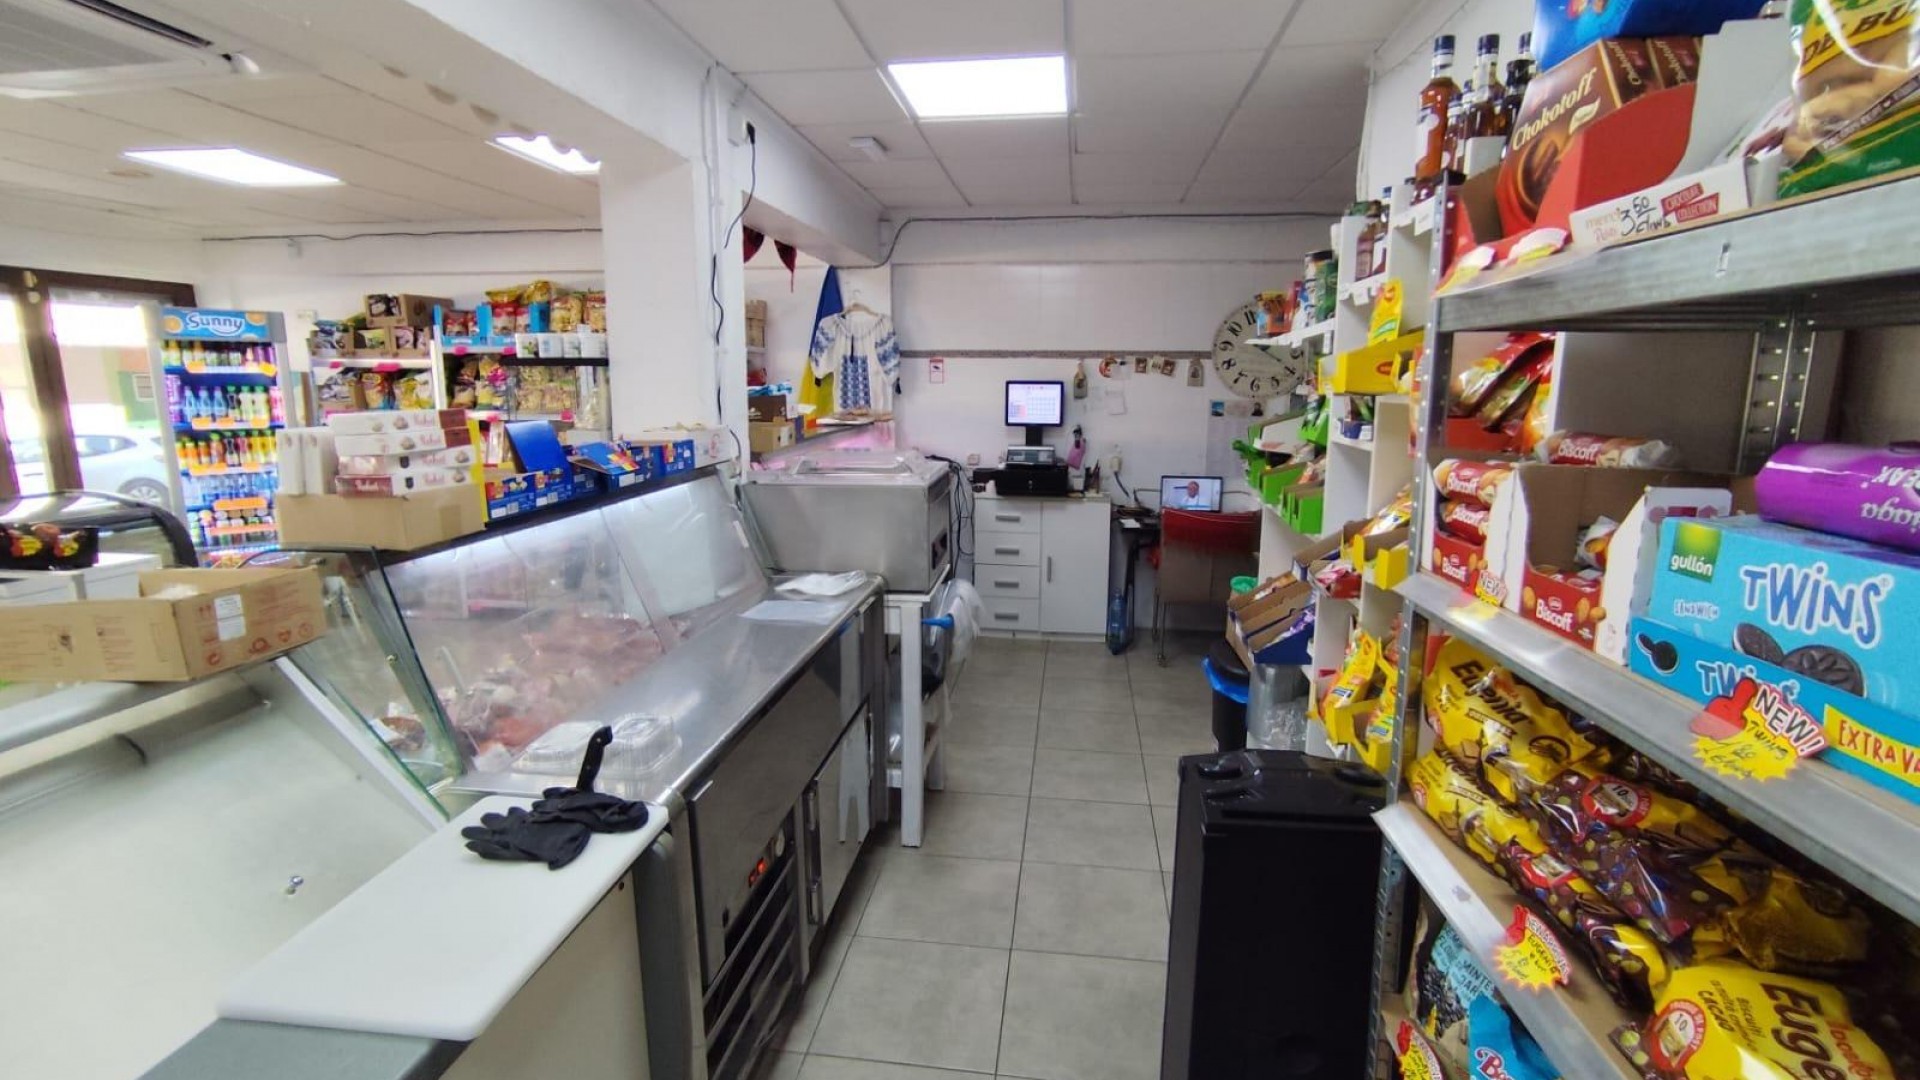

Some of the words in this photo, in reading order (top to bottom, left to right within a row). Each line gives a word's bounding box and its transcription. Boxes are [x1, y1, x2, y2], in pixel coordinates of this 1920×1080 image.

[1513, 66, 1597, 150] Chokotoff
[187, 312, 244, 331] Sunny
[1558, 439, 1601, 461] Biscoff
[1447, 473, 1479, 494] Biscoff
[1861, 497, 1920, 533] iaga
[1442, 556, 1467, 582] Biscoff
[1670, 554, 1713, 577] gullón
[1536, 599, 1572, 632] Biscoff
[1451, 660, 1532, 725] Euenia
[1755, 687, 1824, 753] NEW!
[1838, 719, 1896, 763] EXTRA
[1760, 982, 1848, 1080] Euge
